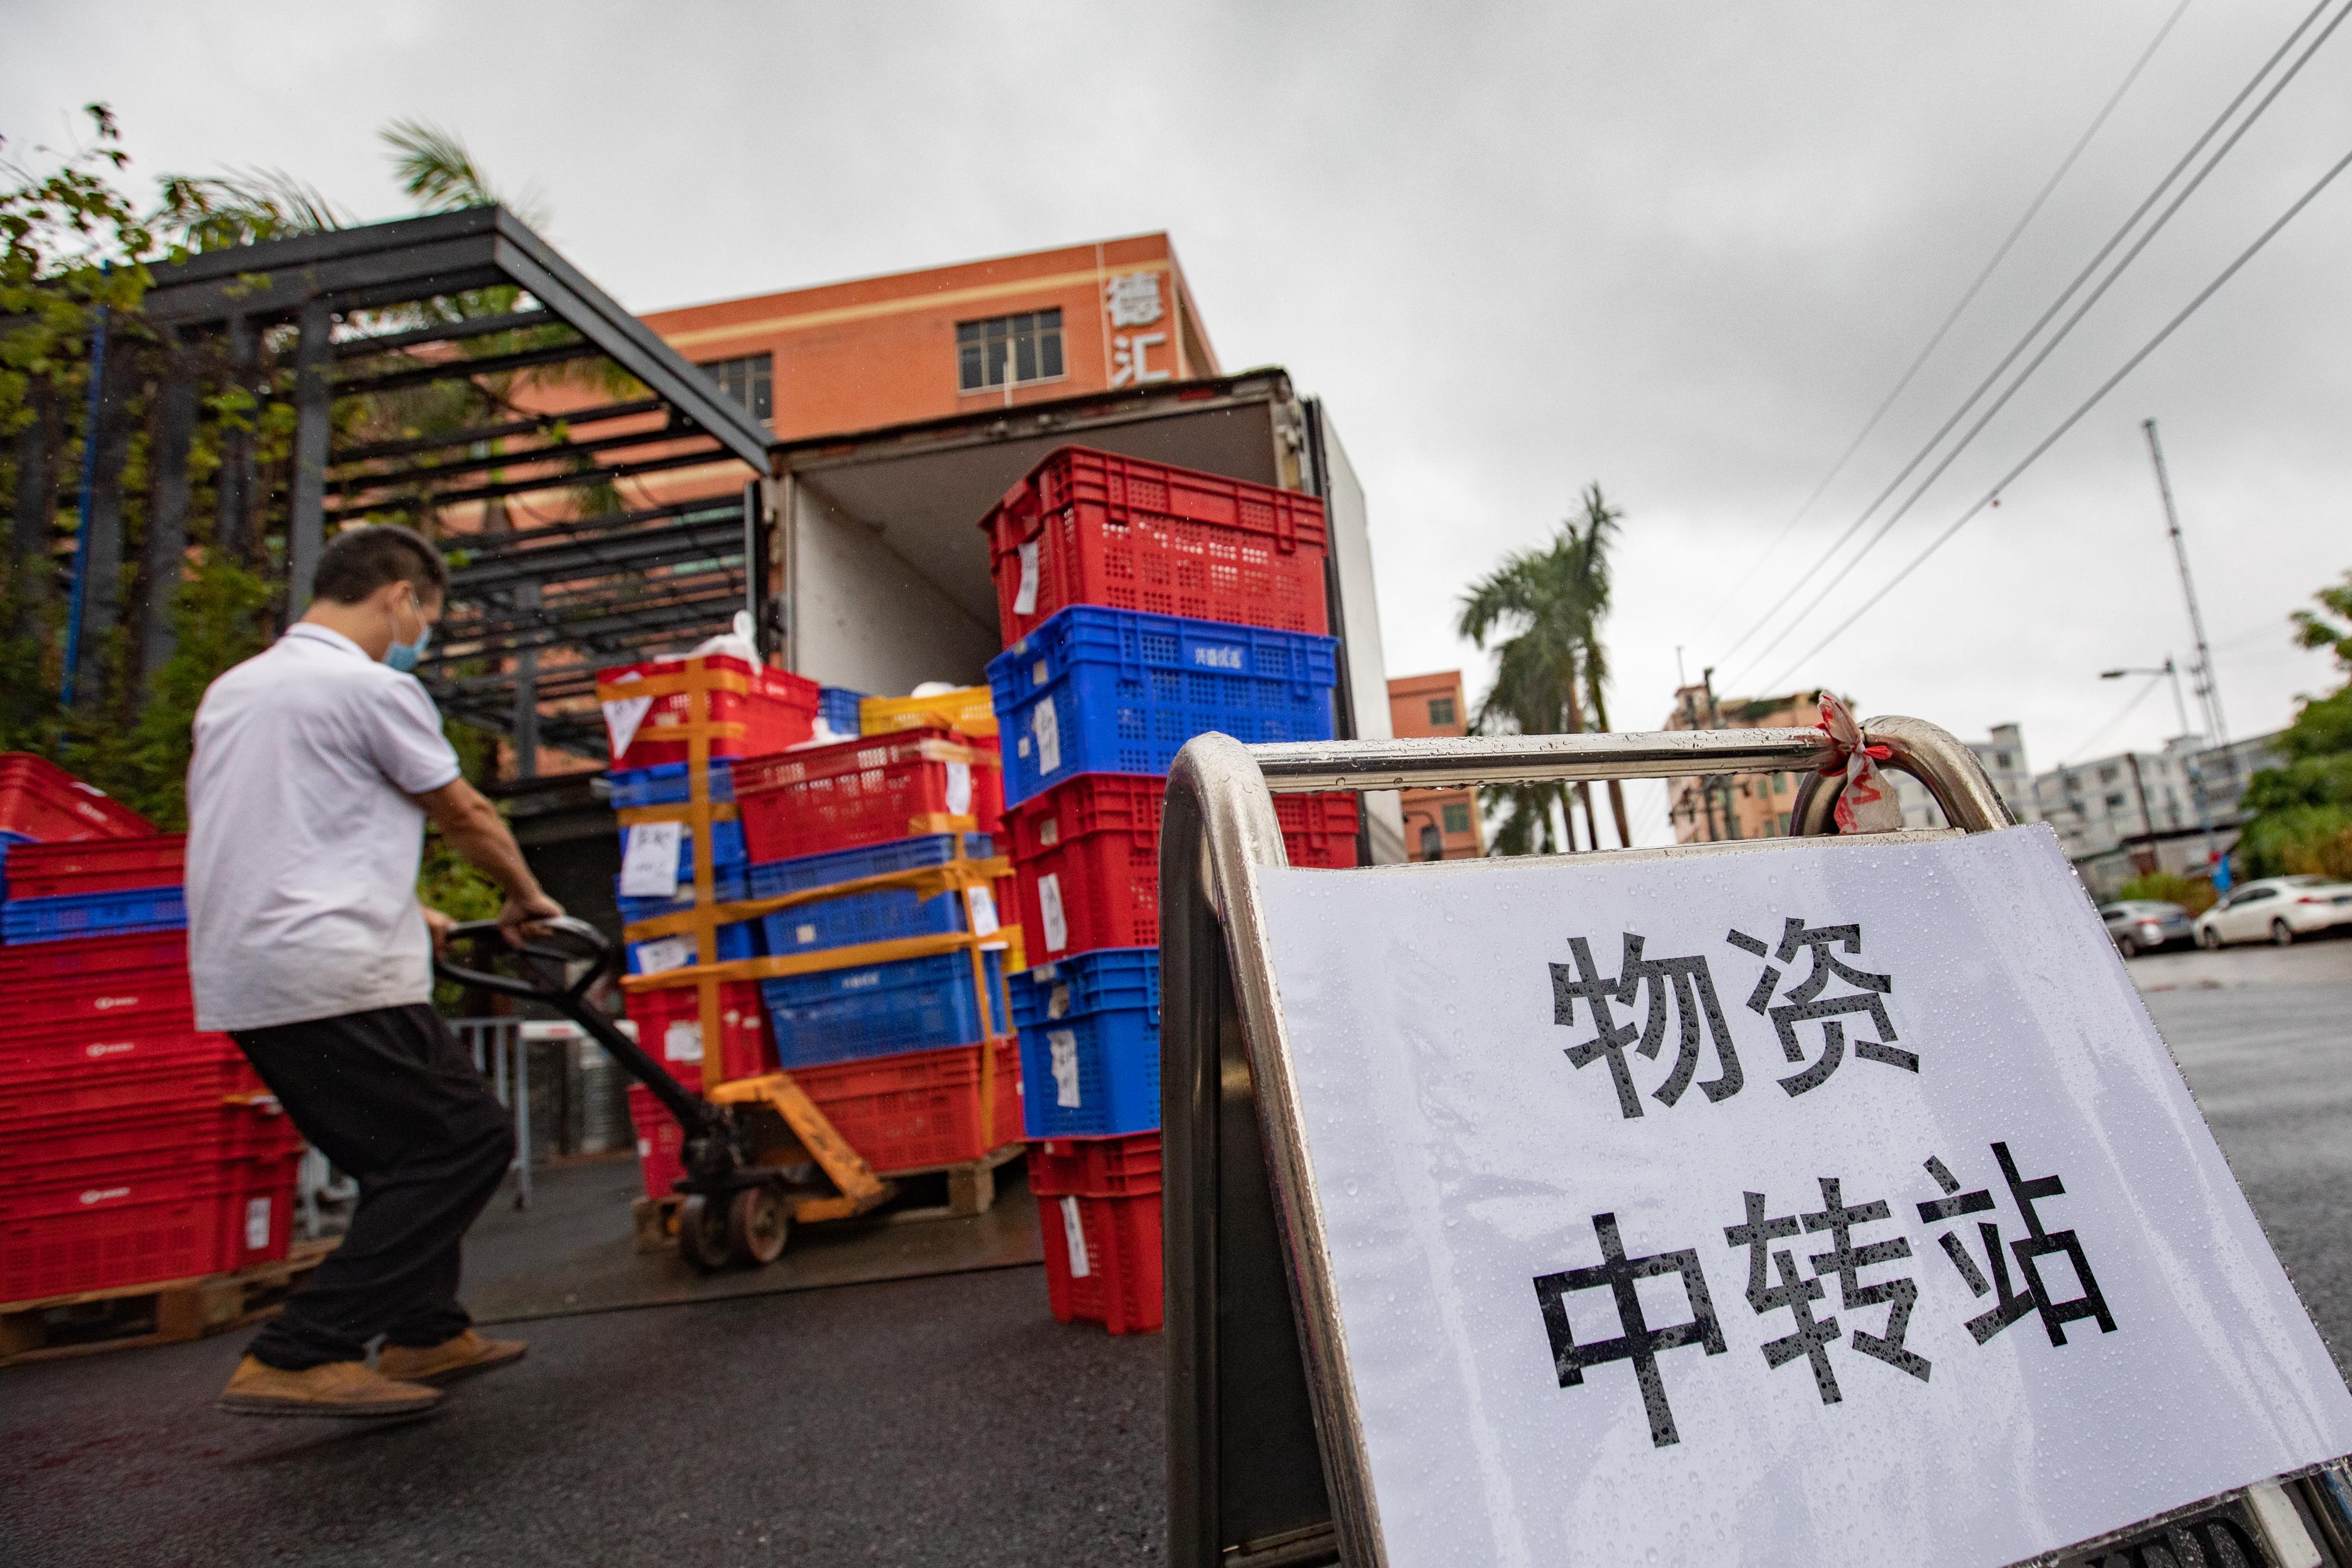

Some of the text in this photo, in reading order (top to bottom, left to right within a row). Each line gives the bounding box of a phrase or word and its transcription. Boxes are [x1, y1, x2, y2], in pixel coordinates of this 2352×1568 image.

[1548, 917, 1919, 1119] 物资
[1533, 1142, 2117, 1448] 中转站
